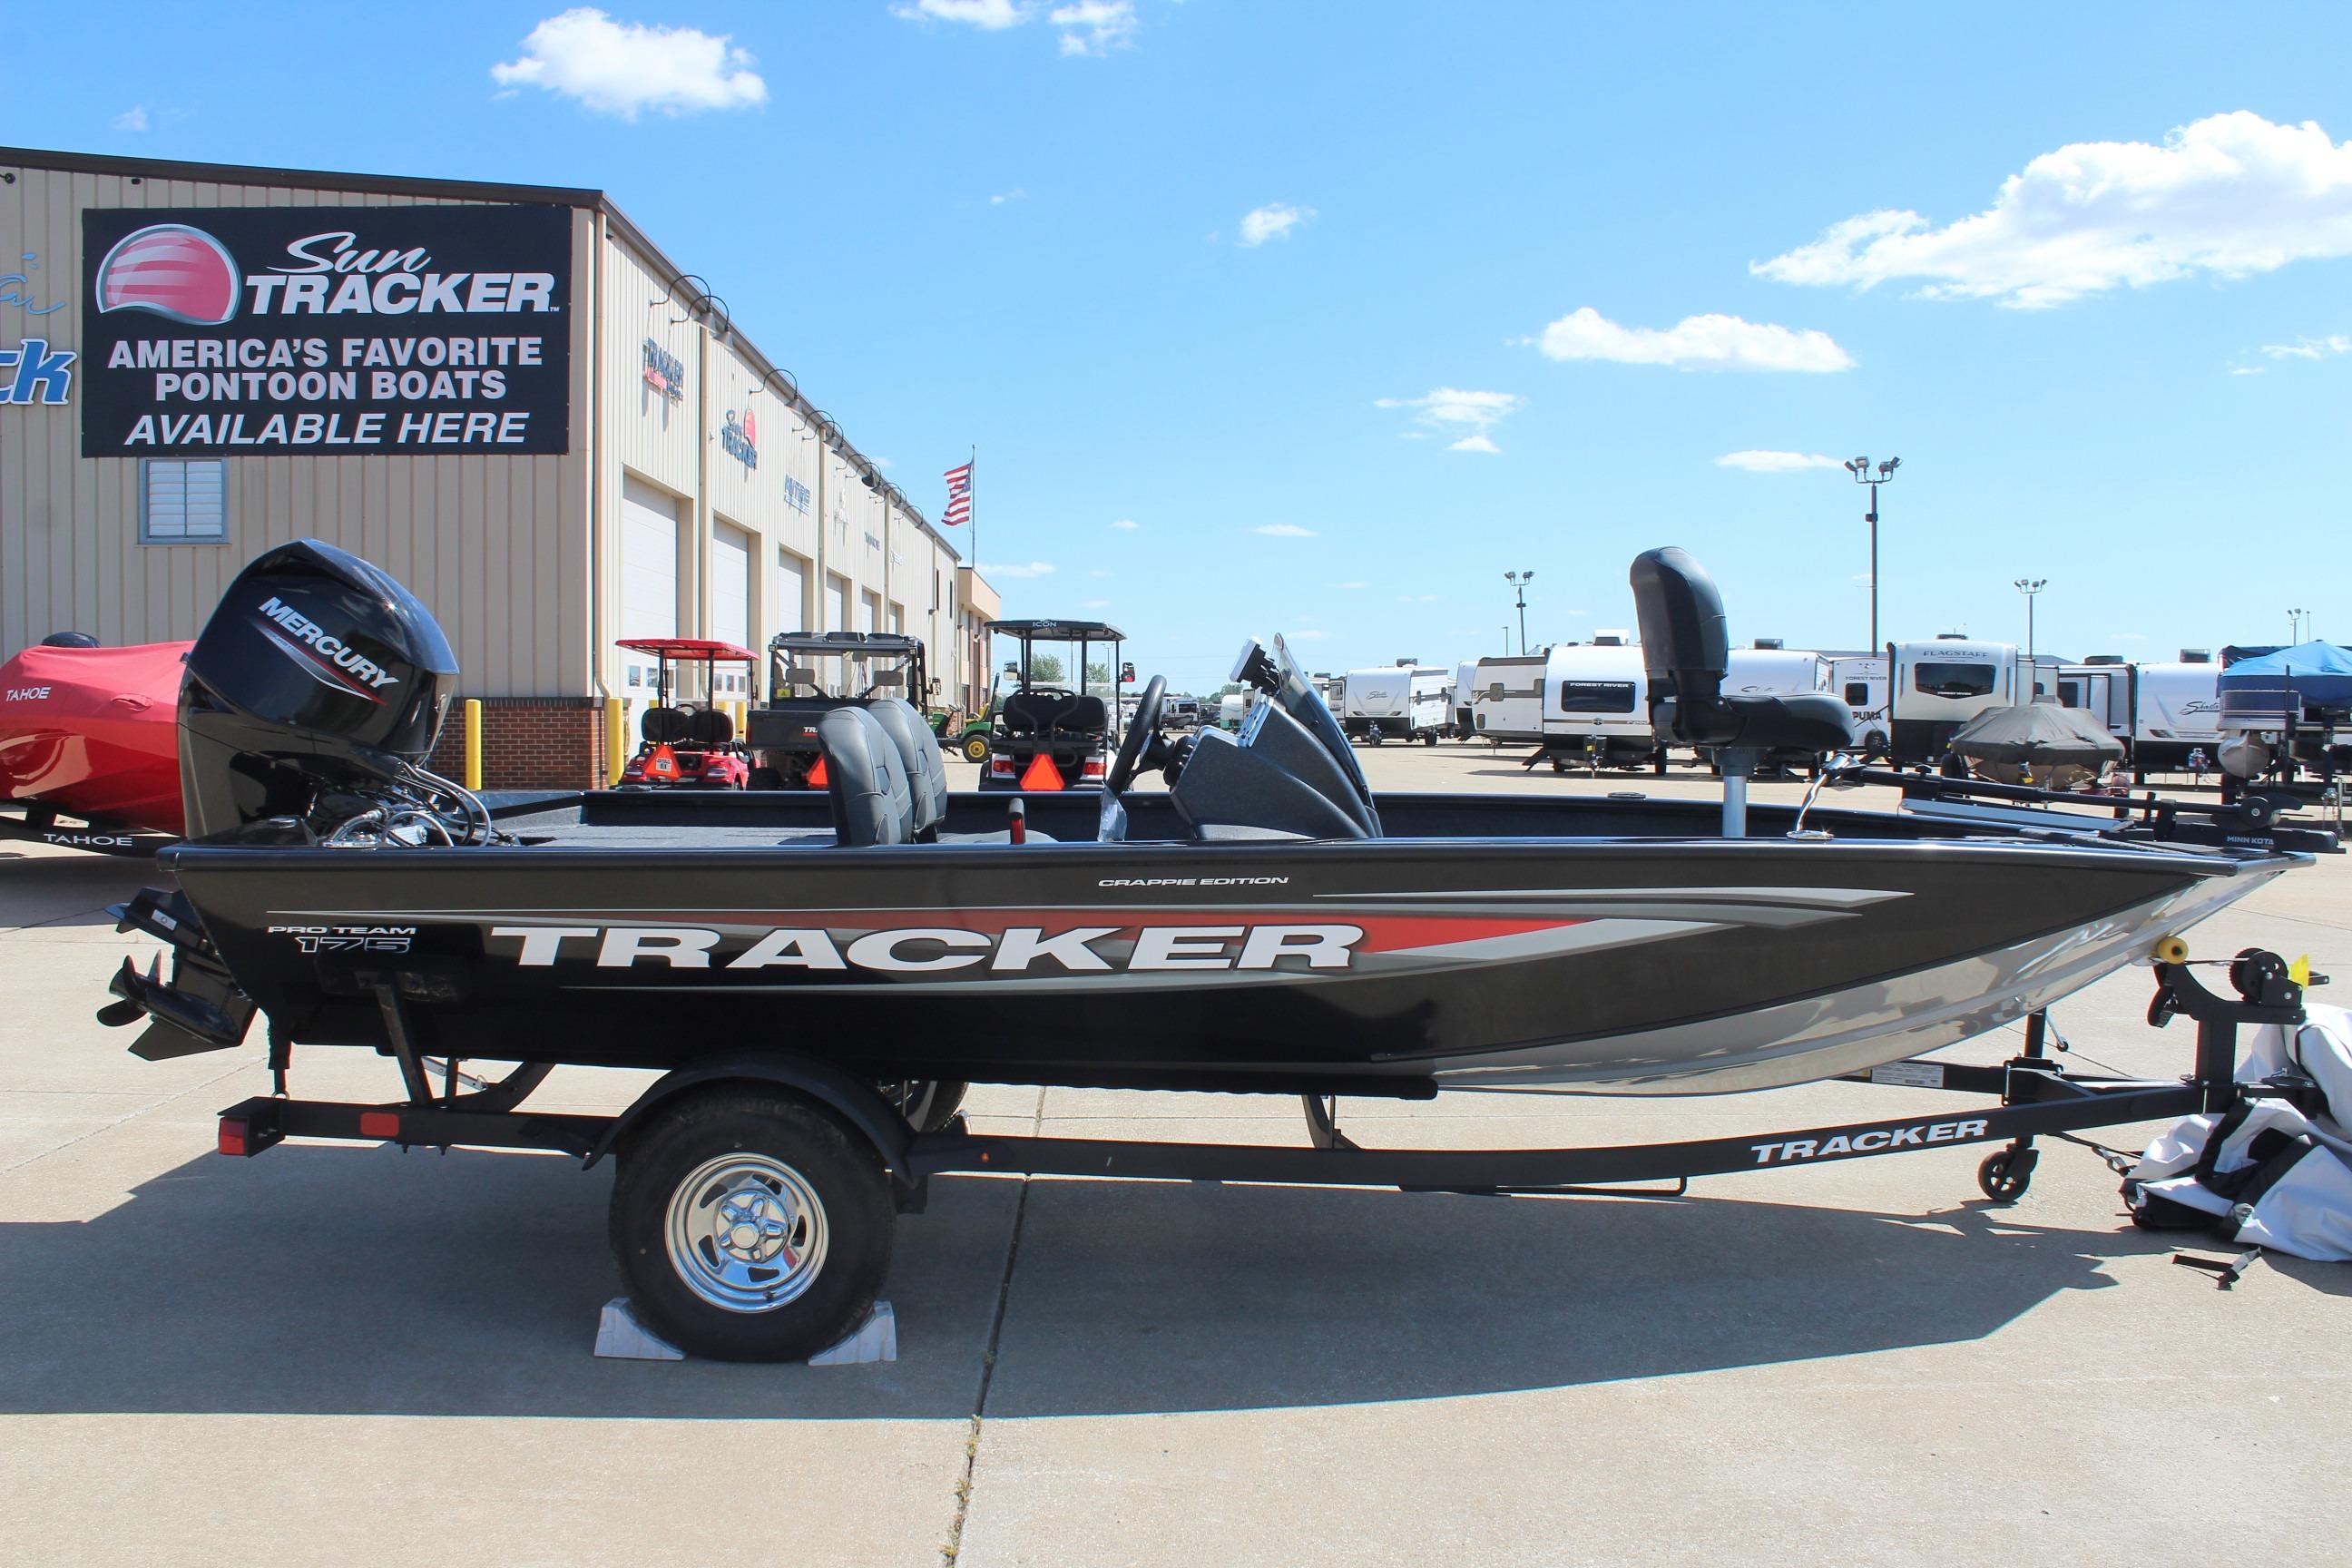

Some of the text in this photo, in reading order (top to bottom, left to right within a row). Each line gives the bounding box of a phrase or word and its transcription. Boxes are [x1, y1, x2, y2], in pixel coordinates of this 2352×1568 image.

[266, 230, 432, 273] Sun
[246, 272, 555, 314] TRACKER
[108, 337, 543, 368] AMERICA'S FAVORITE
[155, 370, 506, 401] PONTOON BOATS
[124, 412, 530, 446] AVAILABLE HERE
[259, 596, 399, 688] MERCURY
[5, 687, 52, 701] TAHOE
[1852, 710, 1882, 720] PUMA
[44, 833, 132, 846] TAHOE
[1098, 877, 1289, 887] CRAPPIE EDITION
[268, 926, 416, 935] PRO TEAM
[295, 936, 411, 953] 175
[491, 924, 1364, 971] TRACKER
[1751, 1119, 1988, 1163] TRACKER
